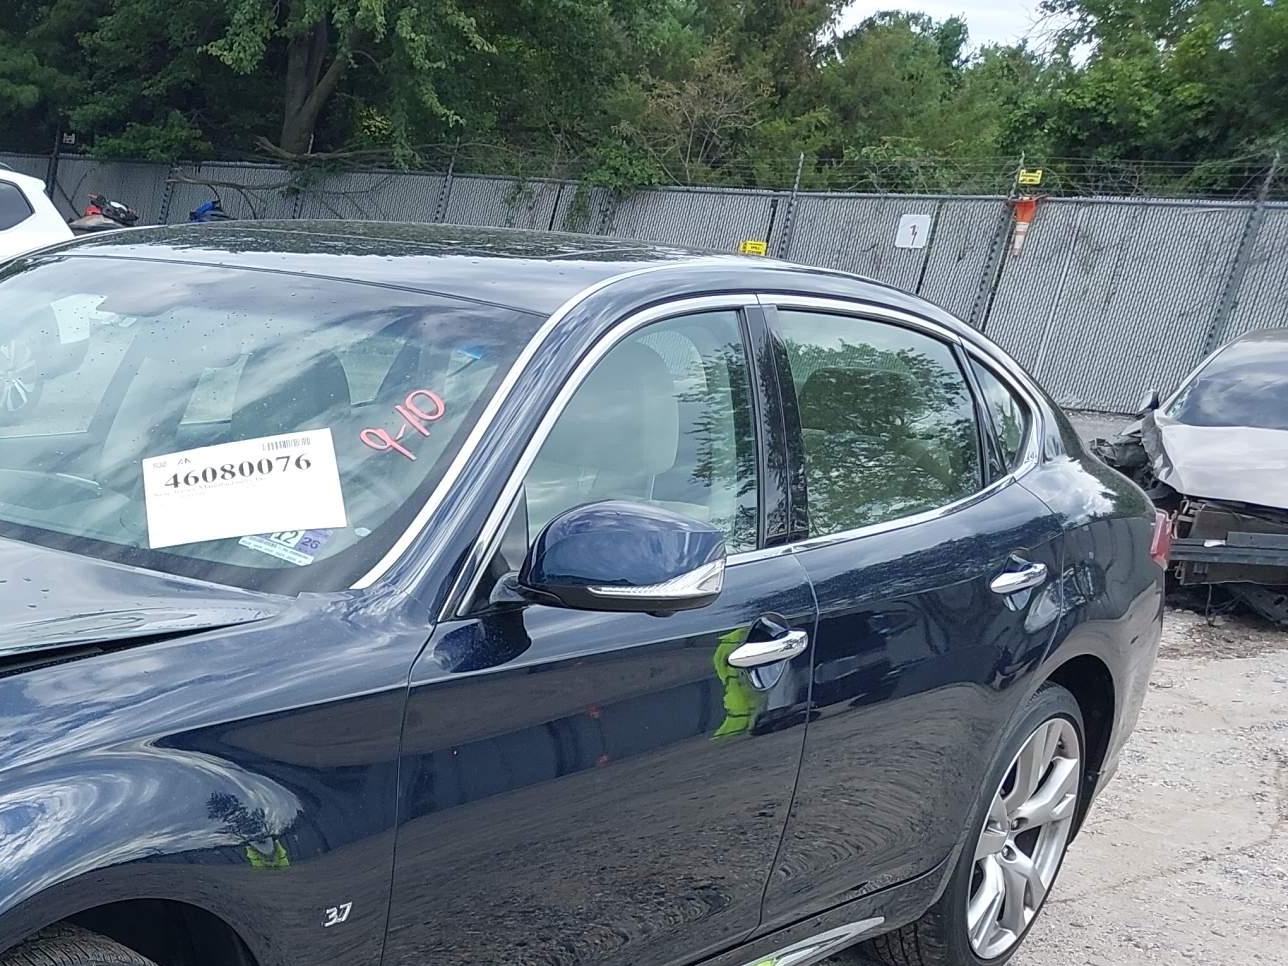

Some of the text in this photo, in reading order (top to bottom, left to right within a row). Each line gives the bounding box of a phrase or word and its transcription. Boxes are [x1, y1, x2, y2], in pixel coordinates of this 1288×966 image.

[360, 389, 445, 461] 9-10
[164, 454, 312, 489] 46080076
[300, 536, 321, 549] 26
